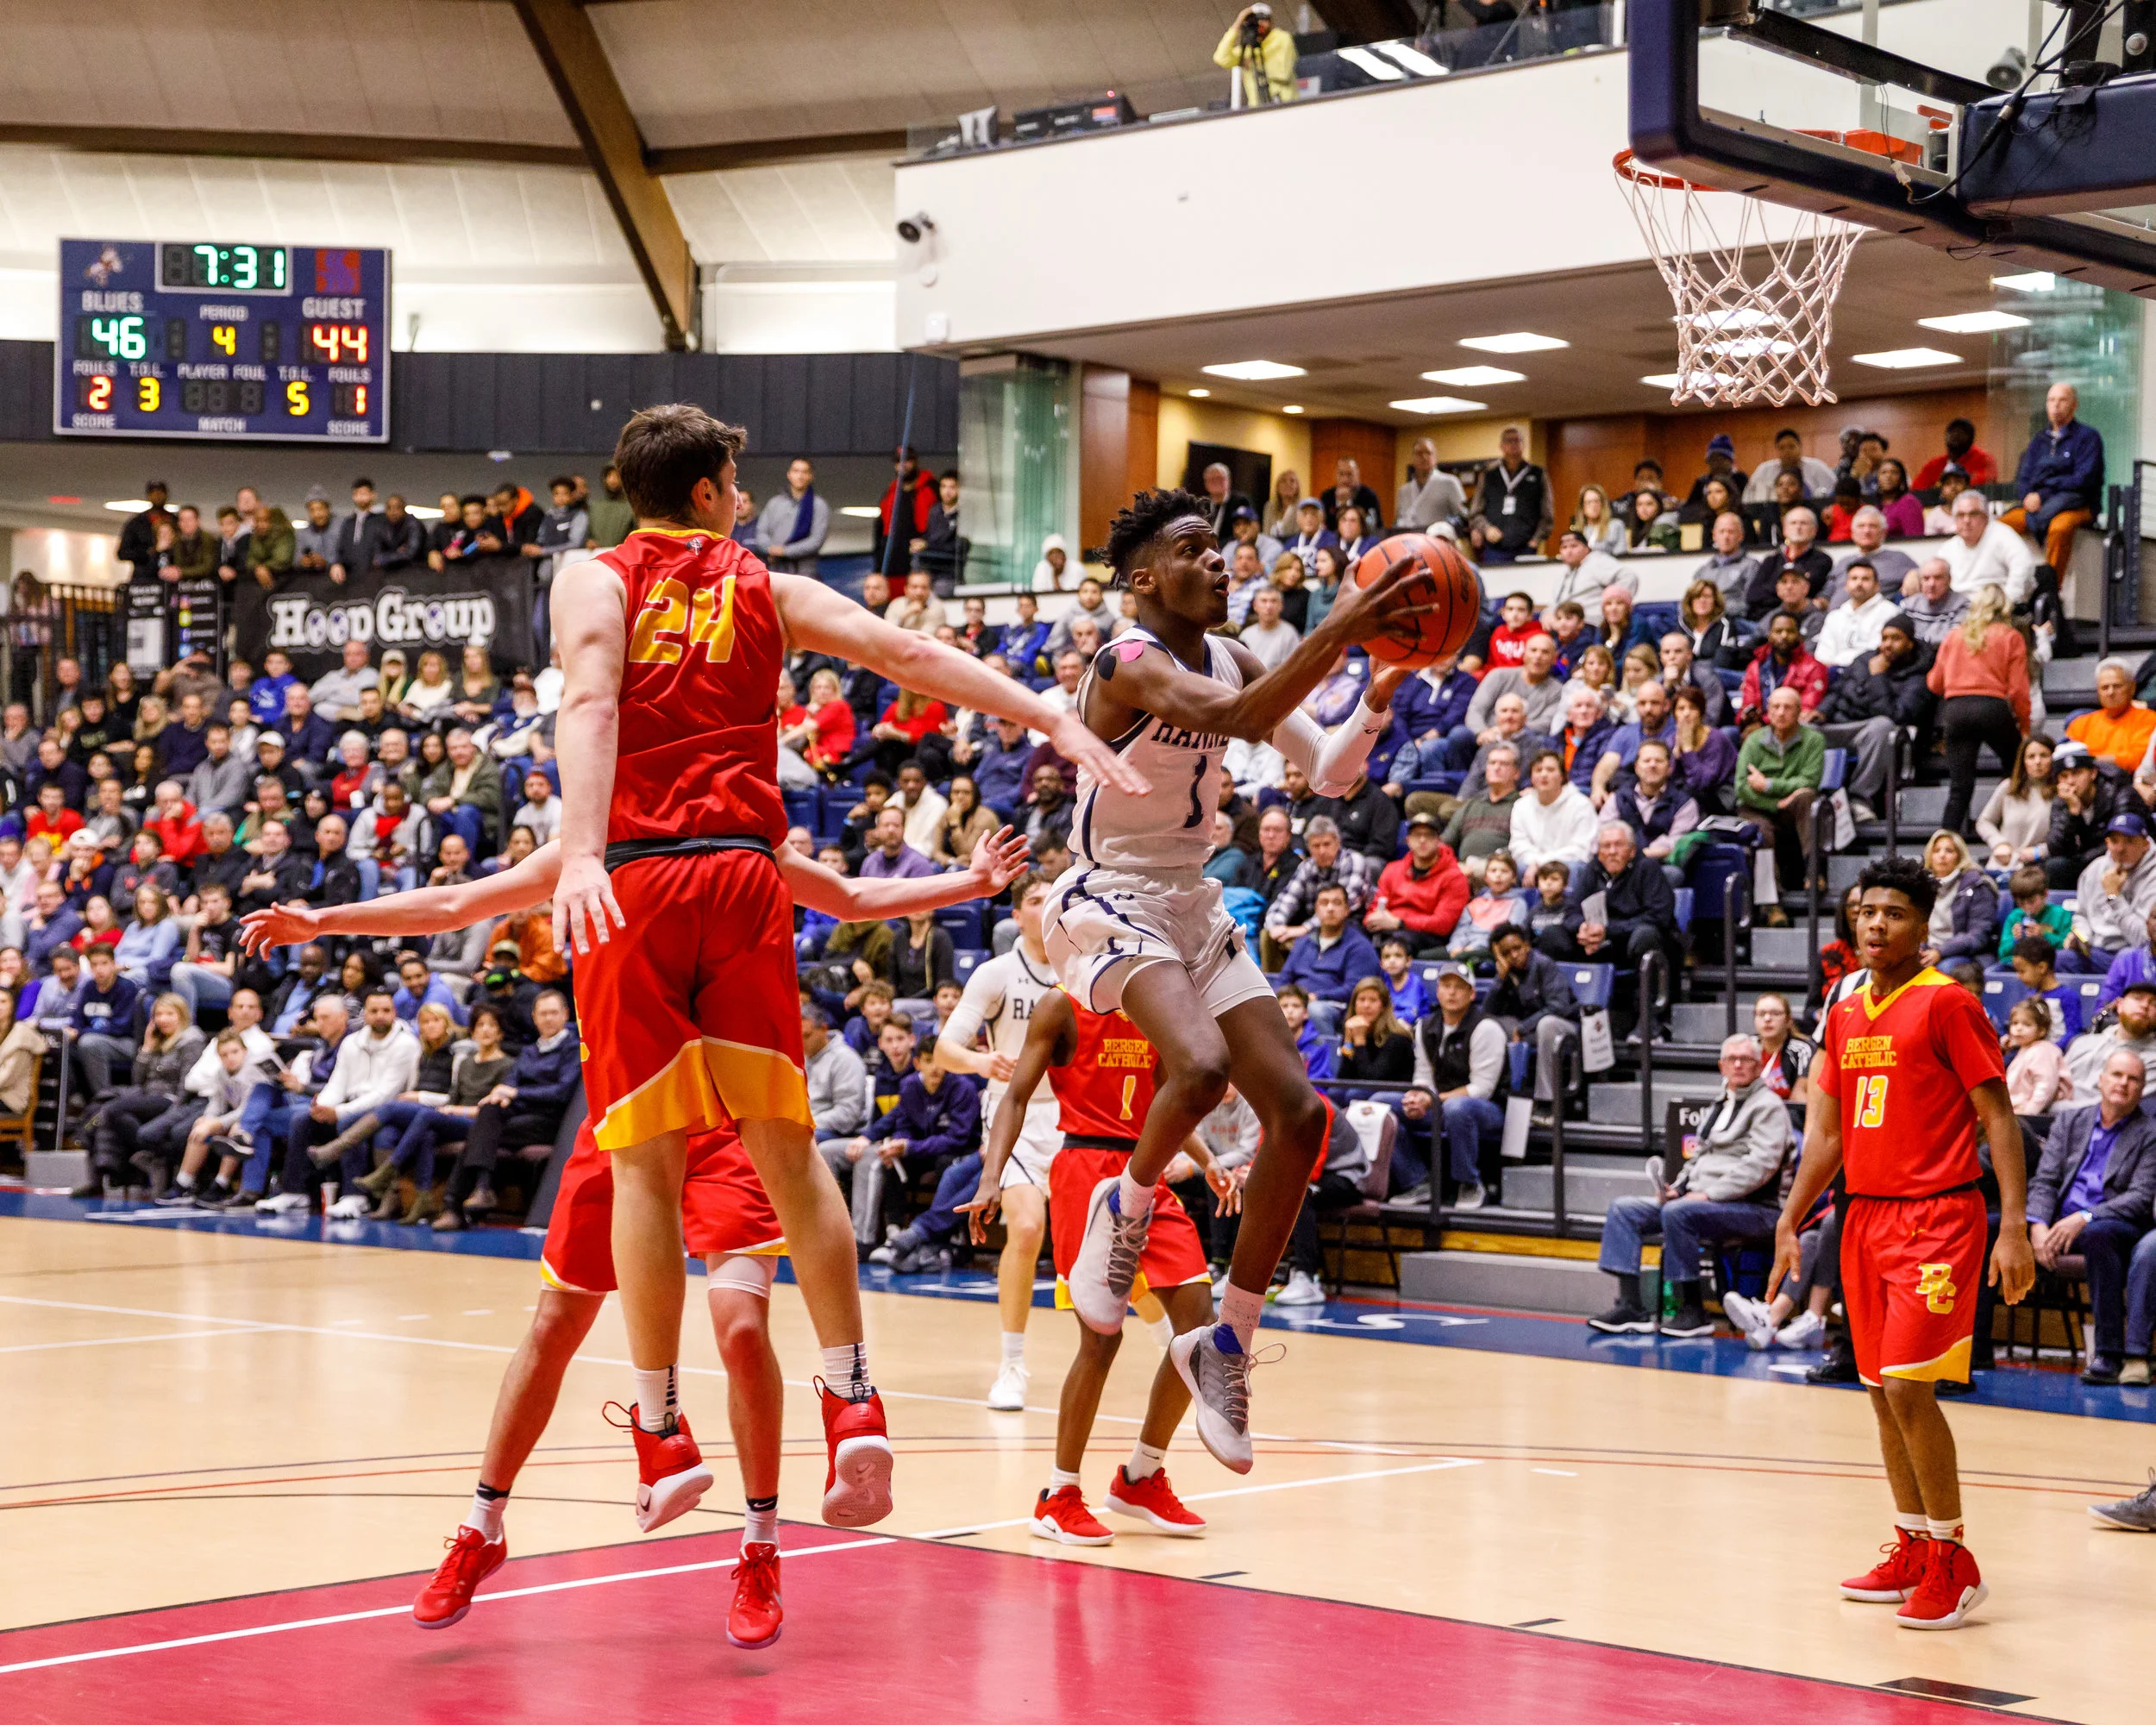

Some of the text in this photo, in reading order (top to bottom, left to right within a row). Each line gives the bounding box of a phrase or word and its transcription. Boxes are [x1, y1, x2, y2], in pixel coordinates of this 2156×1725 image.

[194, 245, 285, 289] 7:31
[82, 291, 144, 314] BLUES
[199, 304, 248, 322] PERIOD
[302, 298, 366, 319] GUEST
[91, 316, 147, 359] 46
[213, 326, 236, 356] 4
[312, 324, 368, 363] 44
[73, 361, 116, 377] FOULS
[178, 364, 268, 381] PLAYER FOUL
[328, 367, 372, 383] FOULS
[88, 375, 112, 411] 2
[139, 377, 161, 412] 3
[286, 381, 310, 416] 5
[354, 385, 367, 415] 1
[72, 414, 116, 430] SCORE
[198, 417, 247, 434] MATCH
[328, 420, 370, 436] SCORE
[628, 575, 736, 665] 24
[1182, 755, 1207, 828] 1
[1103, 1038, 1149, 1054] BERGEN
[1846, 1035, 1893, 1053] BERGEN
[1098, 1053, 1152, 1069] CATHOLIC
[1840, 1051, 1896, 1070] CATHOLIC
[1119, 1075, 1137, 1120] 1
[1853, 1075, 1889, 1128] 13
[1915, 1263, 1957, 1314] BC
